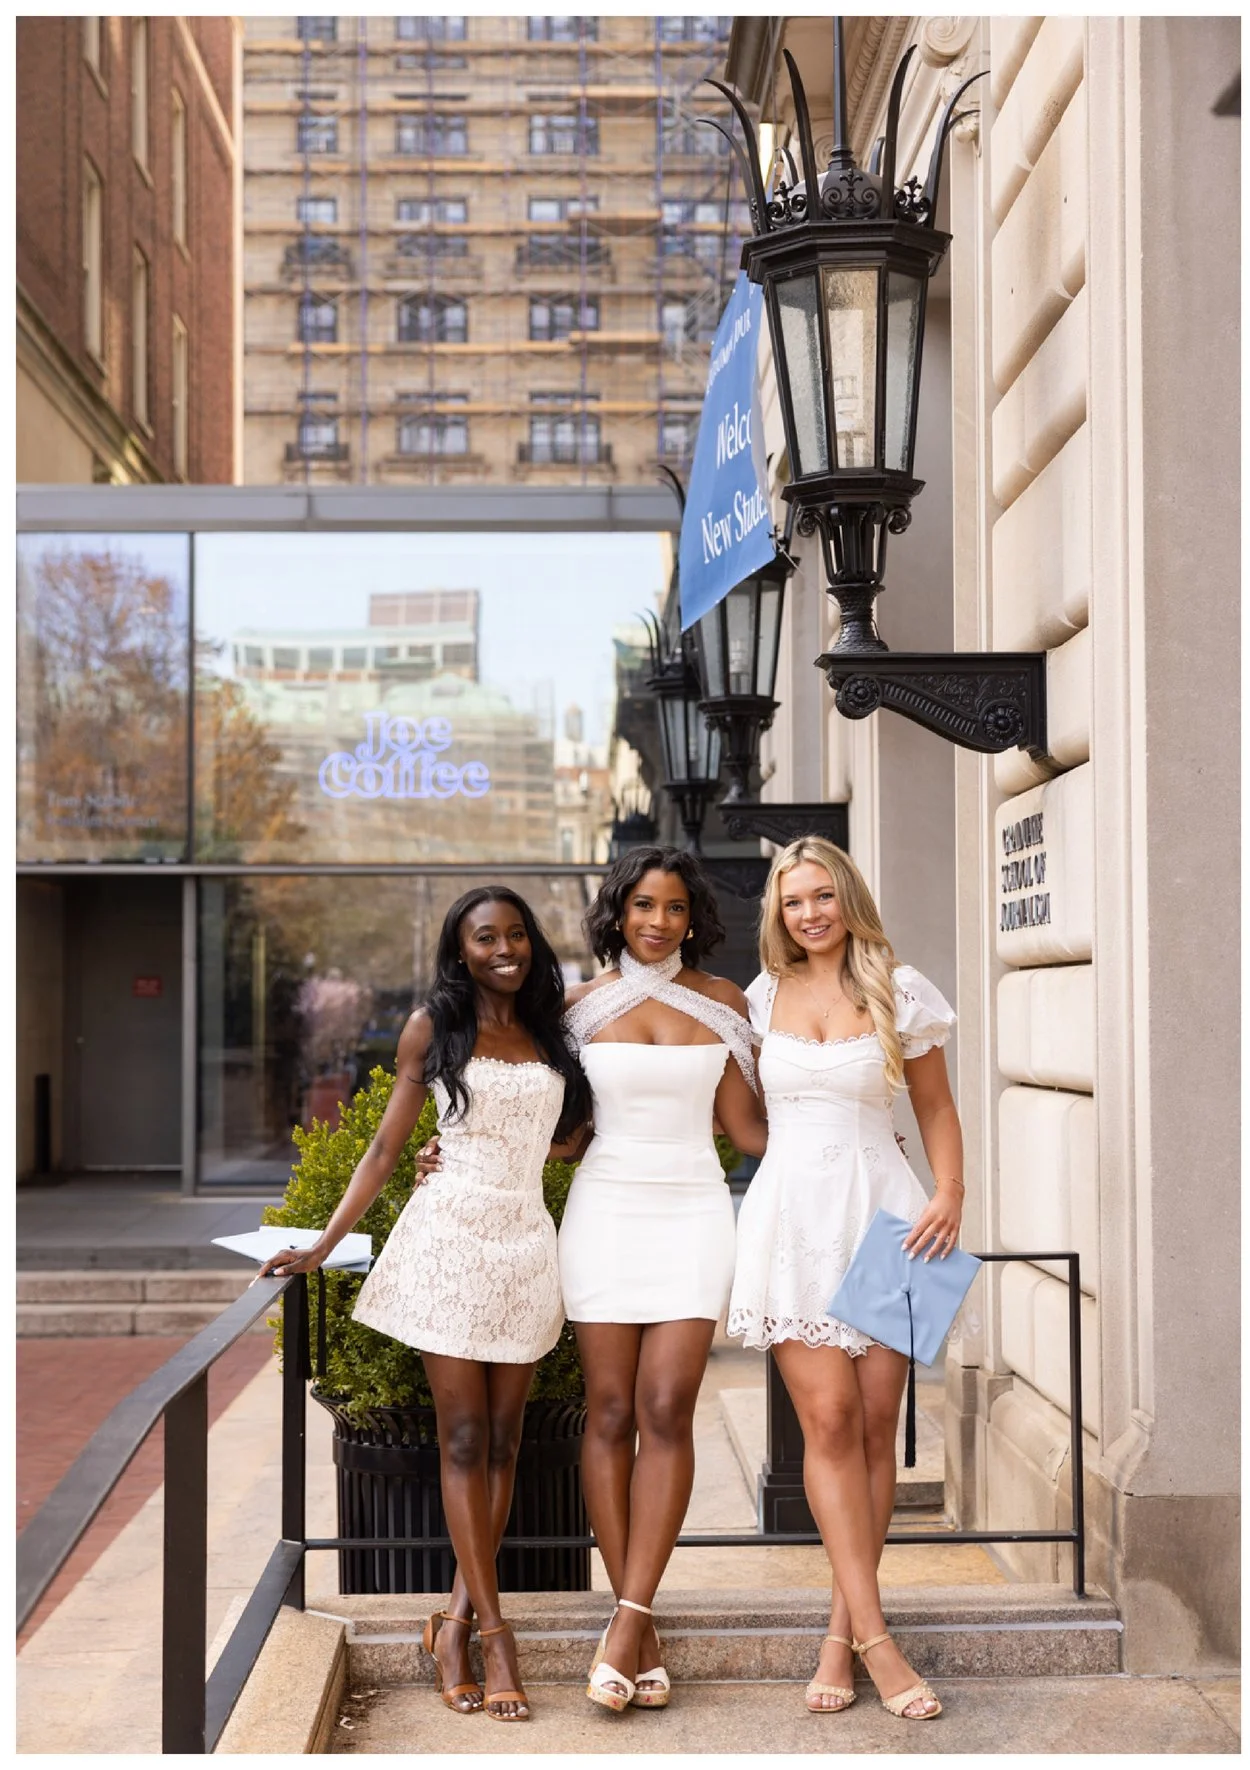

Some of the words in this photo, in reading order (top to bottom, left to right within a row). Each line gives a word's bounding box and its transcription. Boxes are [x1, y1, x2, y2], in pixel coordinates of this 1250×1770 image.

[701, 511, 732, 565] New
[355, 711, 452, 763] Joe
[318, 750, 491, 799] Coffee
